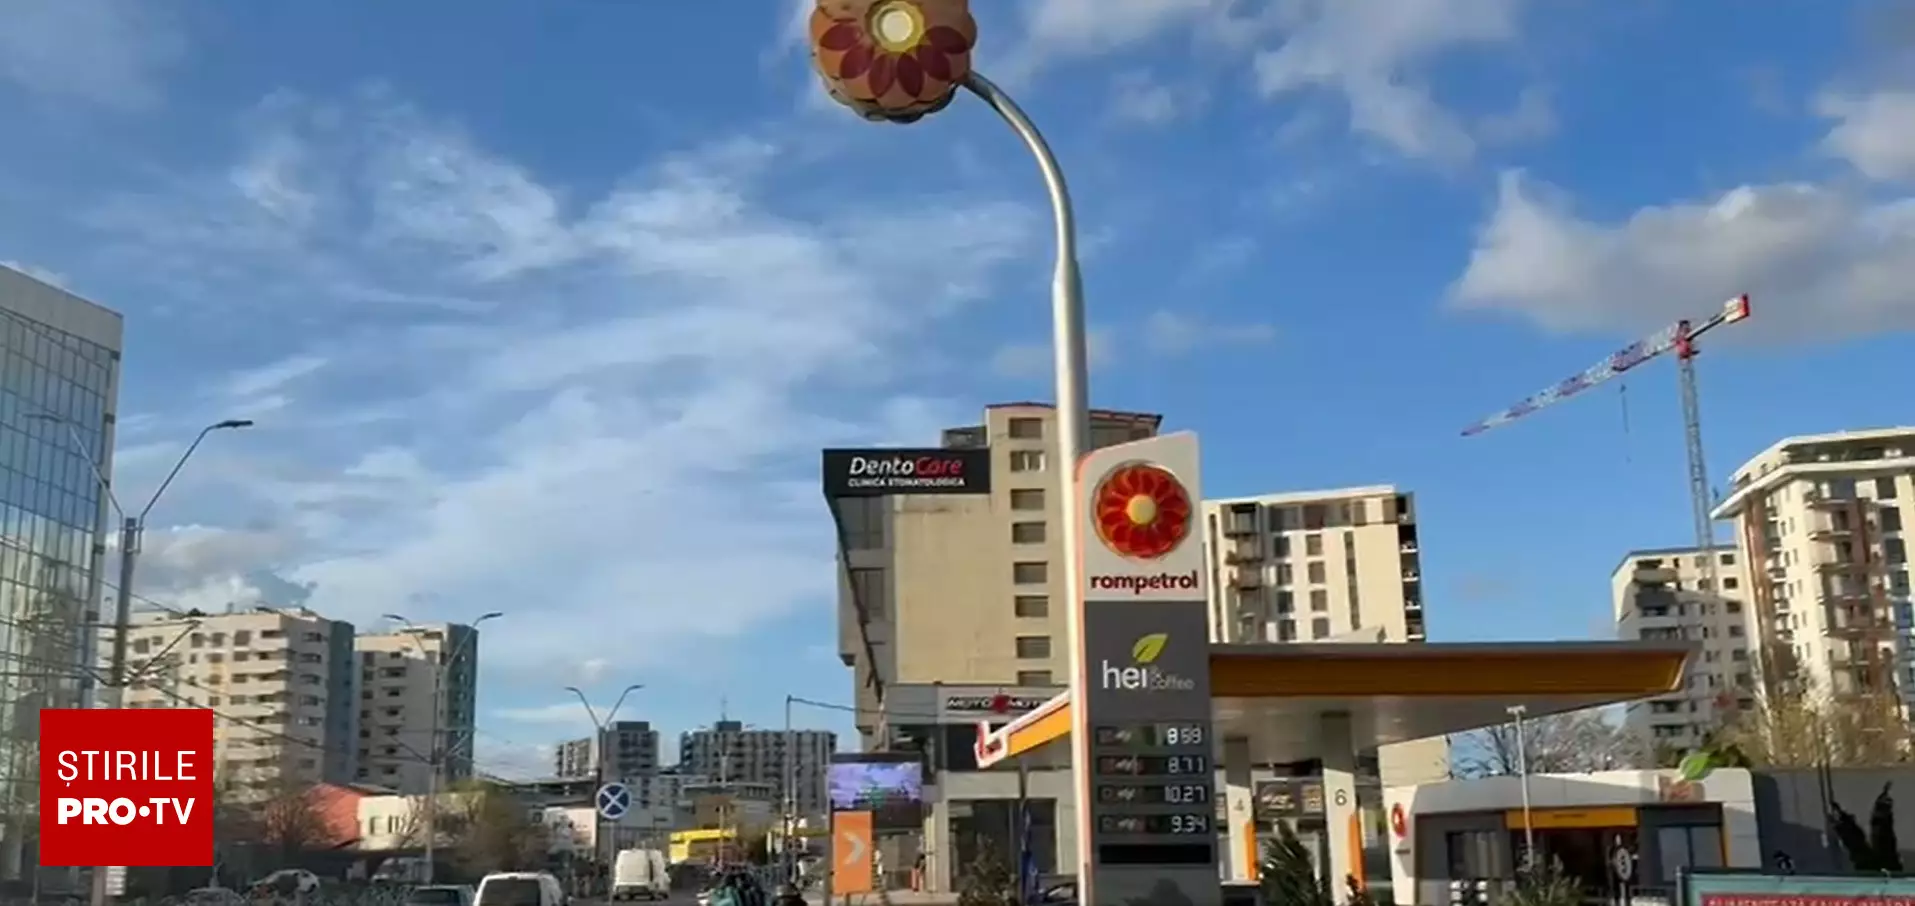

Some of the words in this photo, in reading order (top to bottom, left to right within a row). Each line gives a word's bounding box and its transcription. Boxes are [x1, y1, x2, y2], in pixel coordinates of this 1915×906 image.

[849, 456, 963, 476] DentoCare
[1090, 570, 1199, 595] rompetrol
[1102, 659, 1148, 689] hei
[1165, 785, 1206, 803] 10.27
[1335, 788, 1347, 807] 6
